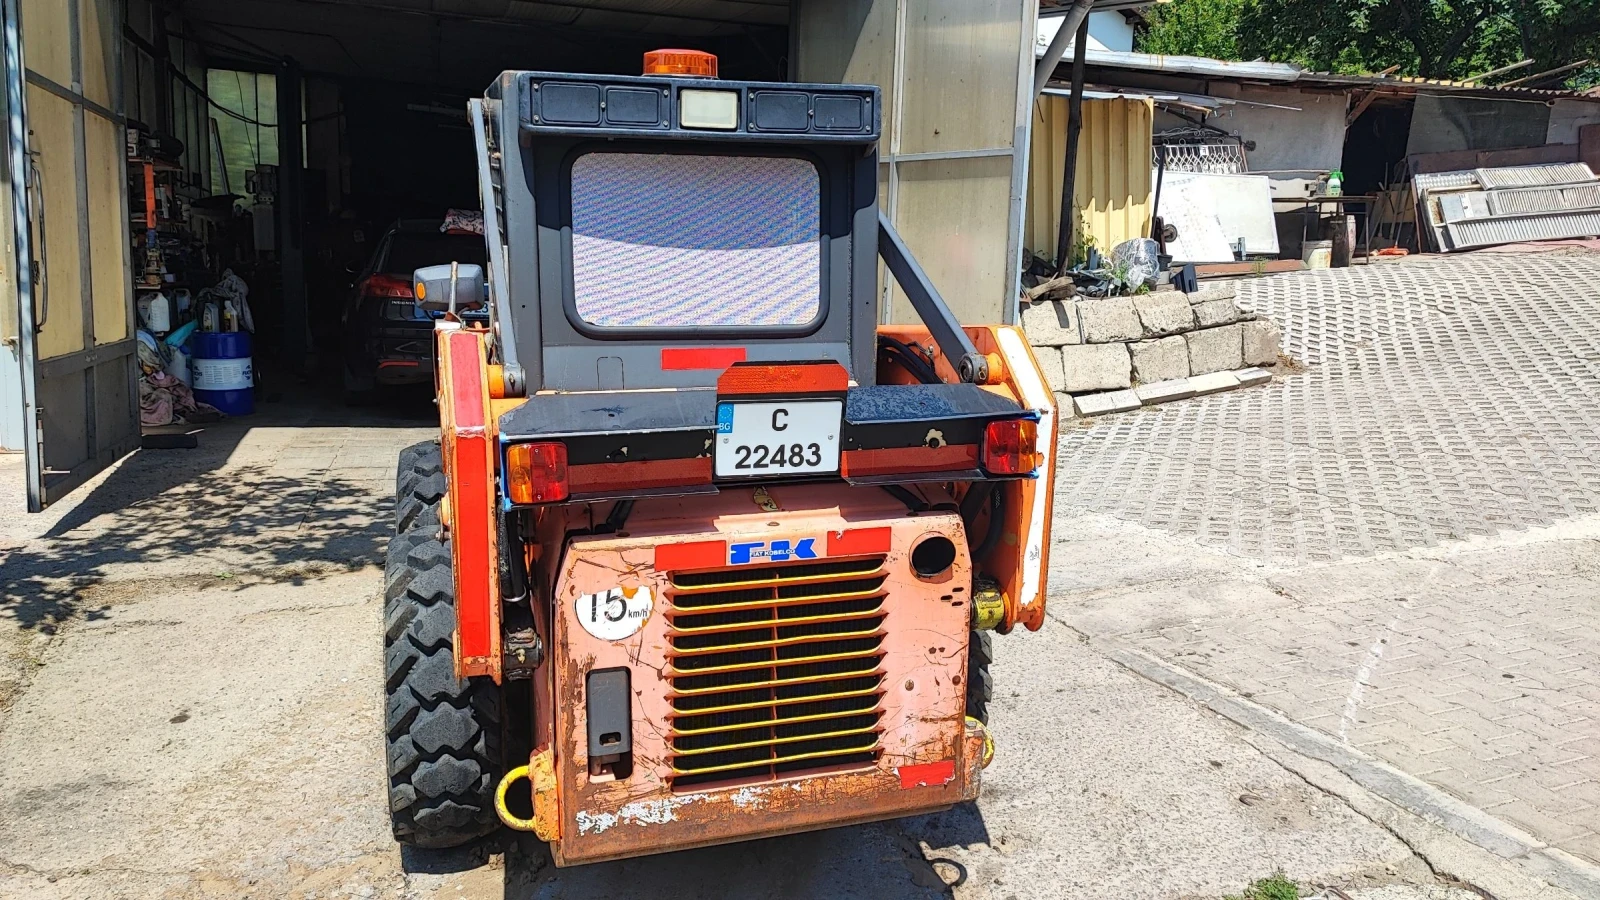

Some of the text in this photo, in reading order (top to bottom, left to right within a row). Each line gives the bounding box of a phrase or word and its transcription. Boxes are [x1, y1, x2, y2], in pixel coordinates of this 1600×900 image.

[718, 422, 731, 431] BG
[772, 408, 789, 432] C
[735, 442, 822, 470] 22483
[591, 589, 648, 623] 15 km/h
